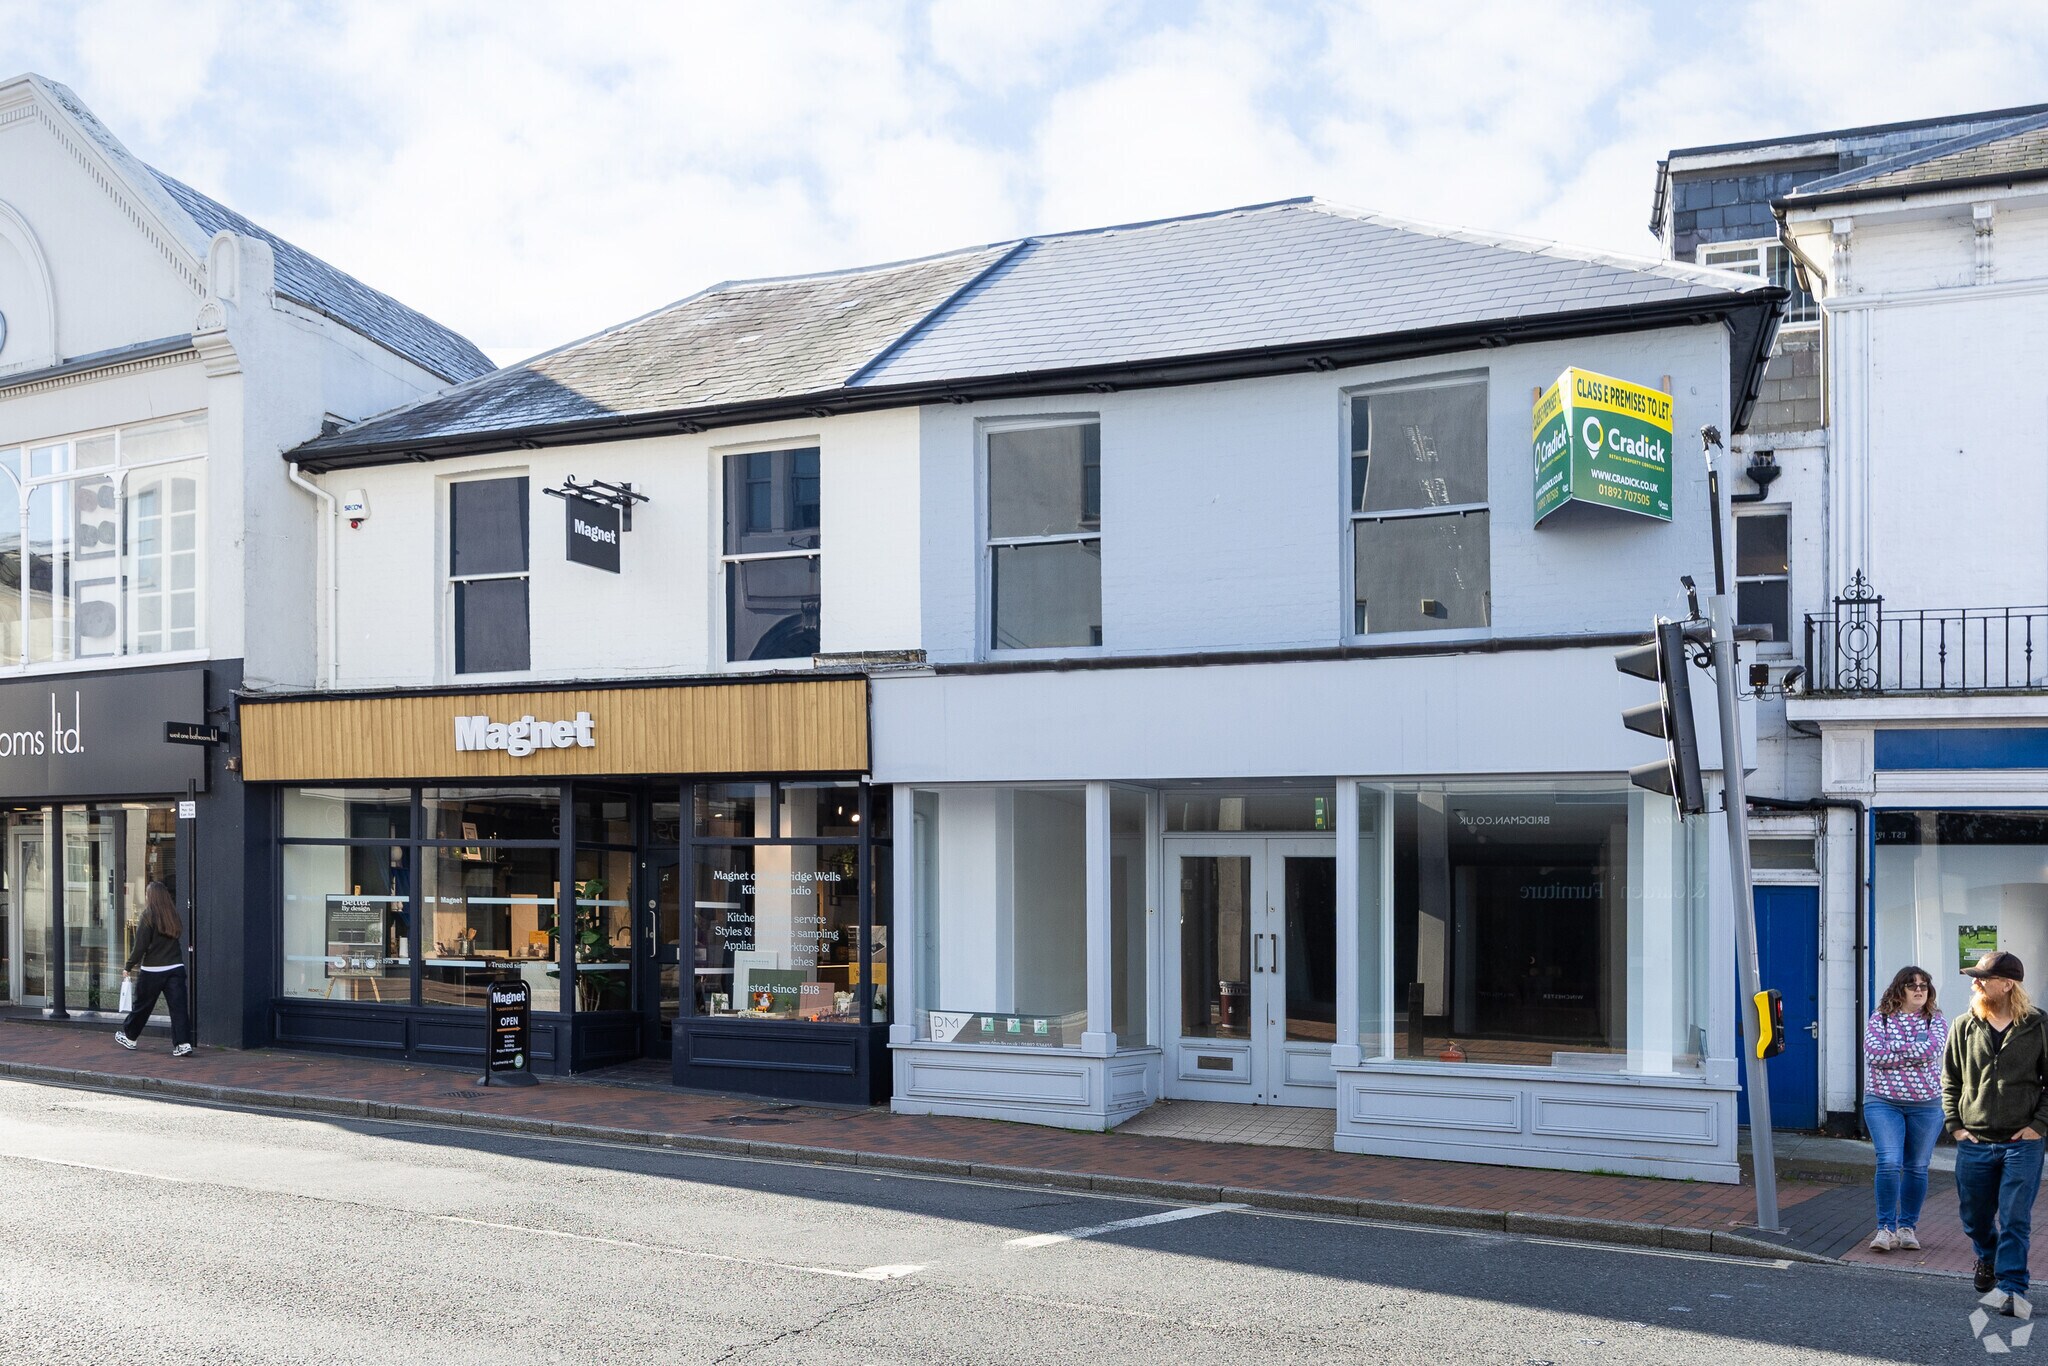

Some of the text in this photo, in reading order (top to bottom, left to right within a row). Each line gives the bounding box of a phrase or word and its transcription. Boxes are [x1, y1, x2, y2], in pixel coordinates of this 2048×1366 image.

[1577, 378, 1669, 420] CLASS E PREMISES TO LET
[1541, 424, 1567, 462] Cradick
[1608, 428, 1665, 463] Cradick
[1609, 453, 1665, 472] RETAIL PROPERTY CONSULTANTS
[1590, 469, 1658, 493] WWW.CRADICK.CO.UK
[1598, 484, 1650, 506] 01892 707505
[574, 518, 616, 545] Magnet
[51, 690, 85, 754] ltd.
[454, 711, 595, 757] Magnet
[713, 870, 749, 882] Magnet
[814, 872, 841, 881] Wells
[440, 896, 463, 904] Magnet
[727, 912, 826, 923] Kitche service
[715, 926, 742, 937] Styles
[744, 927, 752, 936] &
[797, 928, 839, 940] sampling
[821, 943, 830, 952] &
[772, 984, 798, 994] since
[799, 985, 820, 995] 1918
[493, 991, 525, 1004] Magnet
[500, 1017, 518, 1026] OPEN
[933, 1015, 959, 1029] DM
[935, 1029, 945, 1040] P
